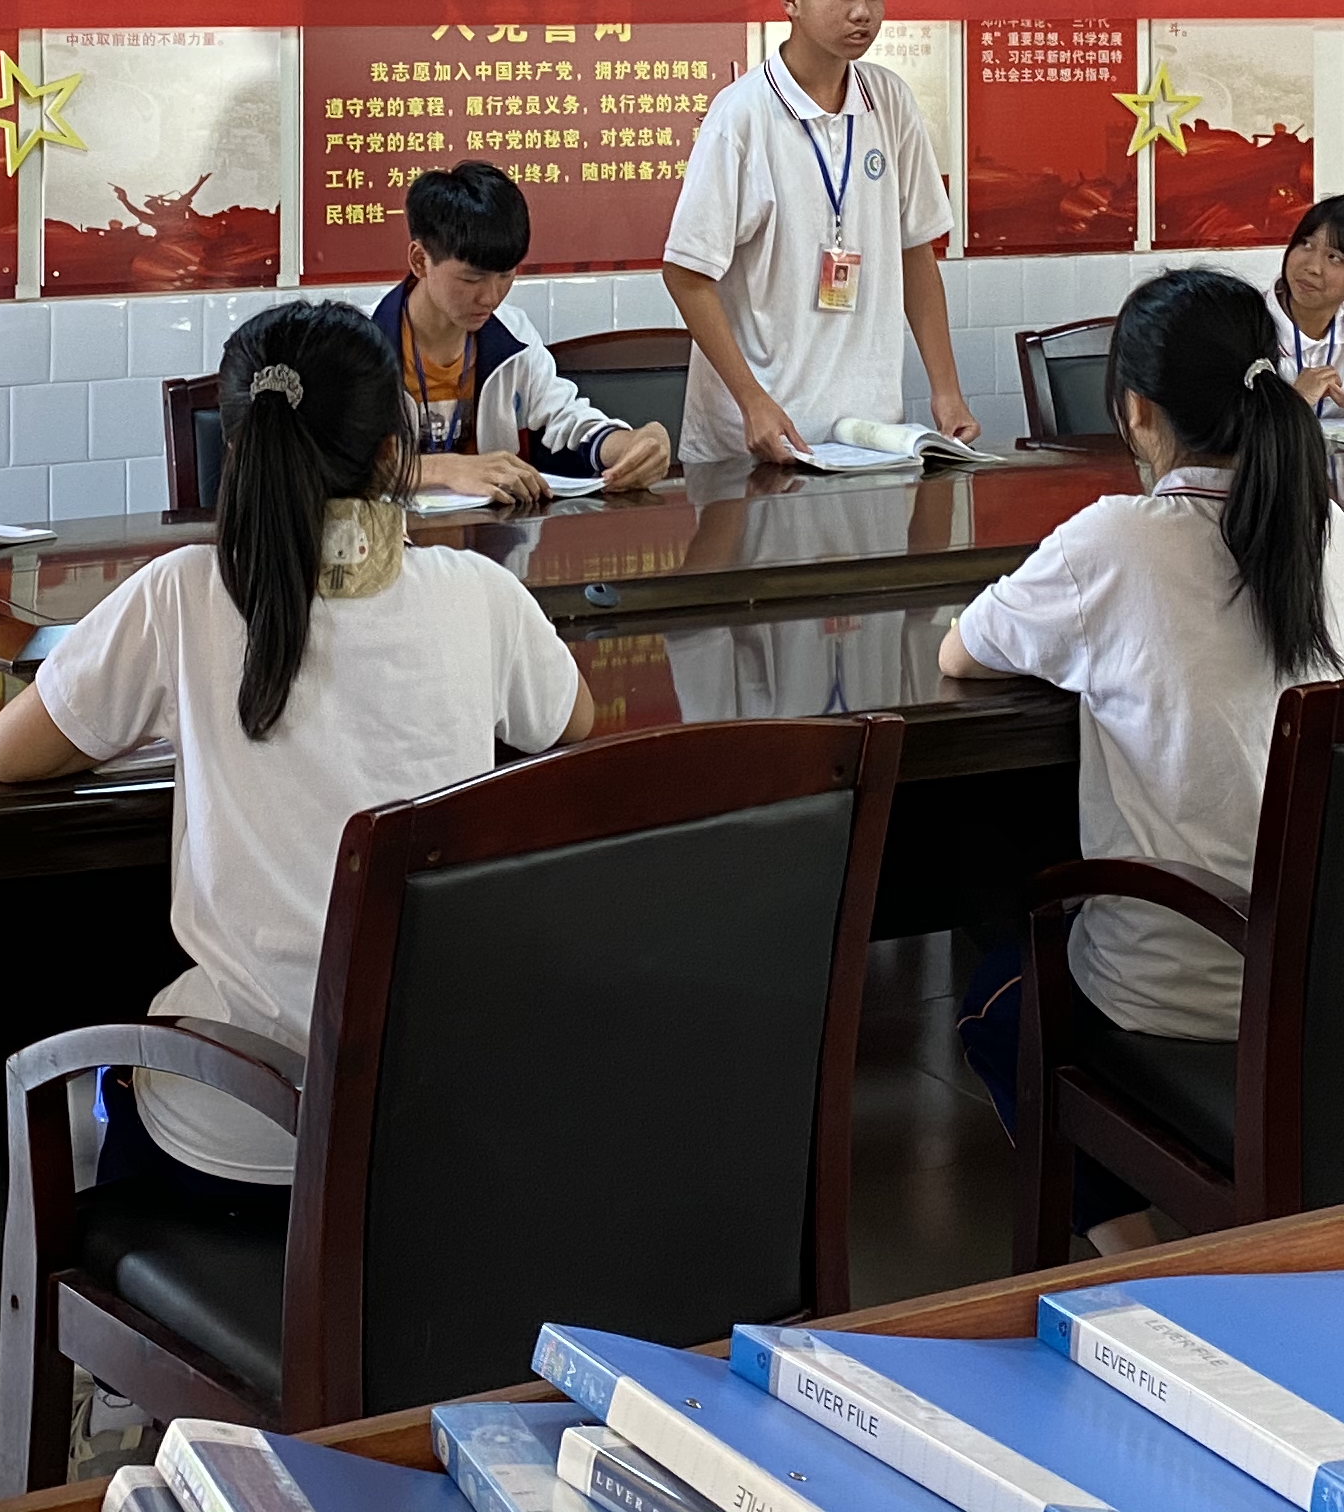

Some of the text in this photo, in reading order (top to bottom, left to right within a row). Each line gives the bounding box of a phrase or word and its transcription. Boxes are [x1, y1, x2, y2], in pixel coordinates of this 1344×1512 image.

[66, 33, 225, 47] 中汲取前进的不竭力量。
[981, 50, 1123, 64] 观、习近平新时代中国特
[370, 60, 717, 83] 我志愿加入中国共产党，拥护党的纲领，
[981, 68, 1118, 82] 色社会主义思想为指导。
[1094, 1340, 1167, 1403] LEVER FILE
[797, 1372, 879, 1439] LEVER FILE
[596, 1470, 644, 1512] LEVER
